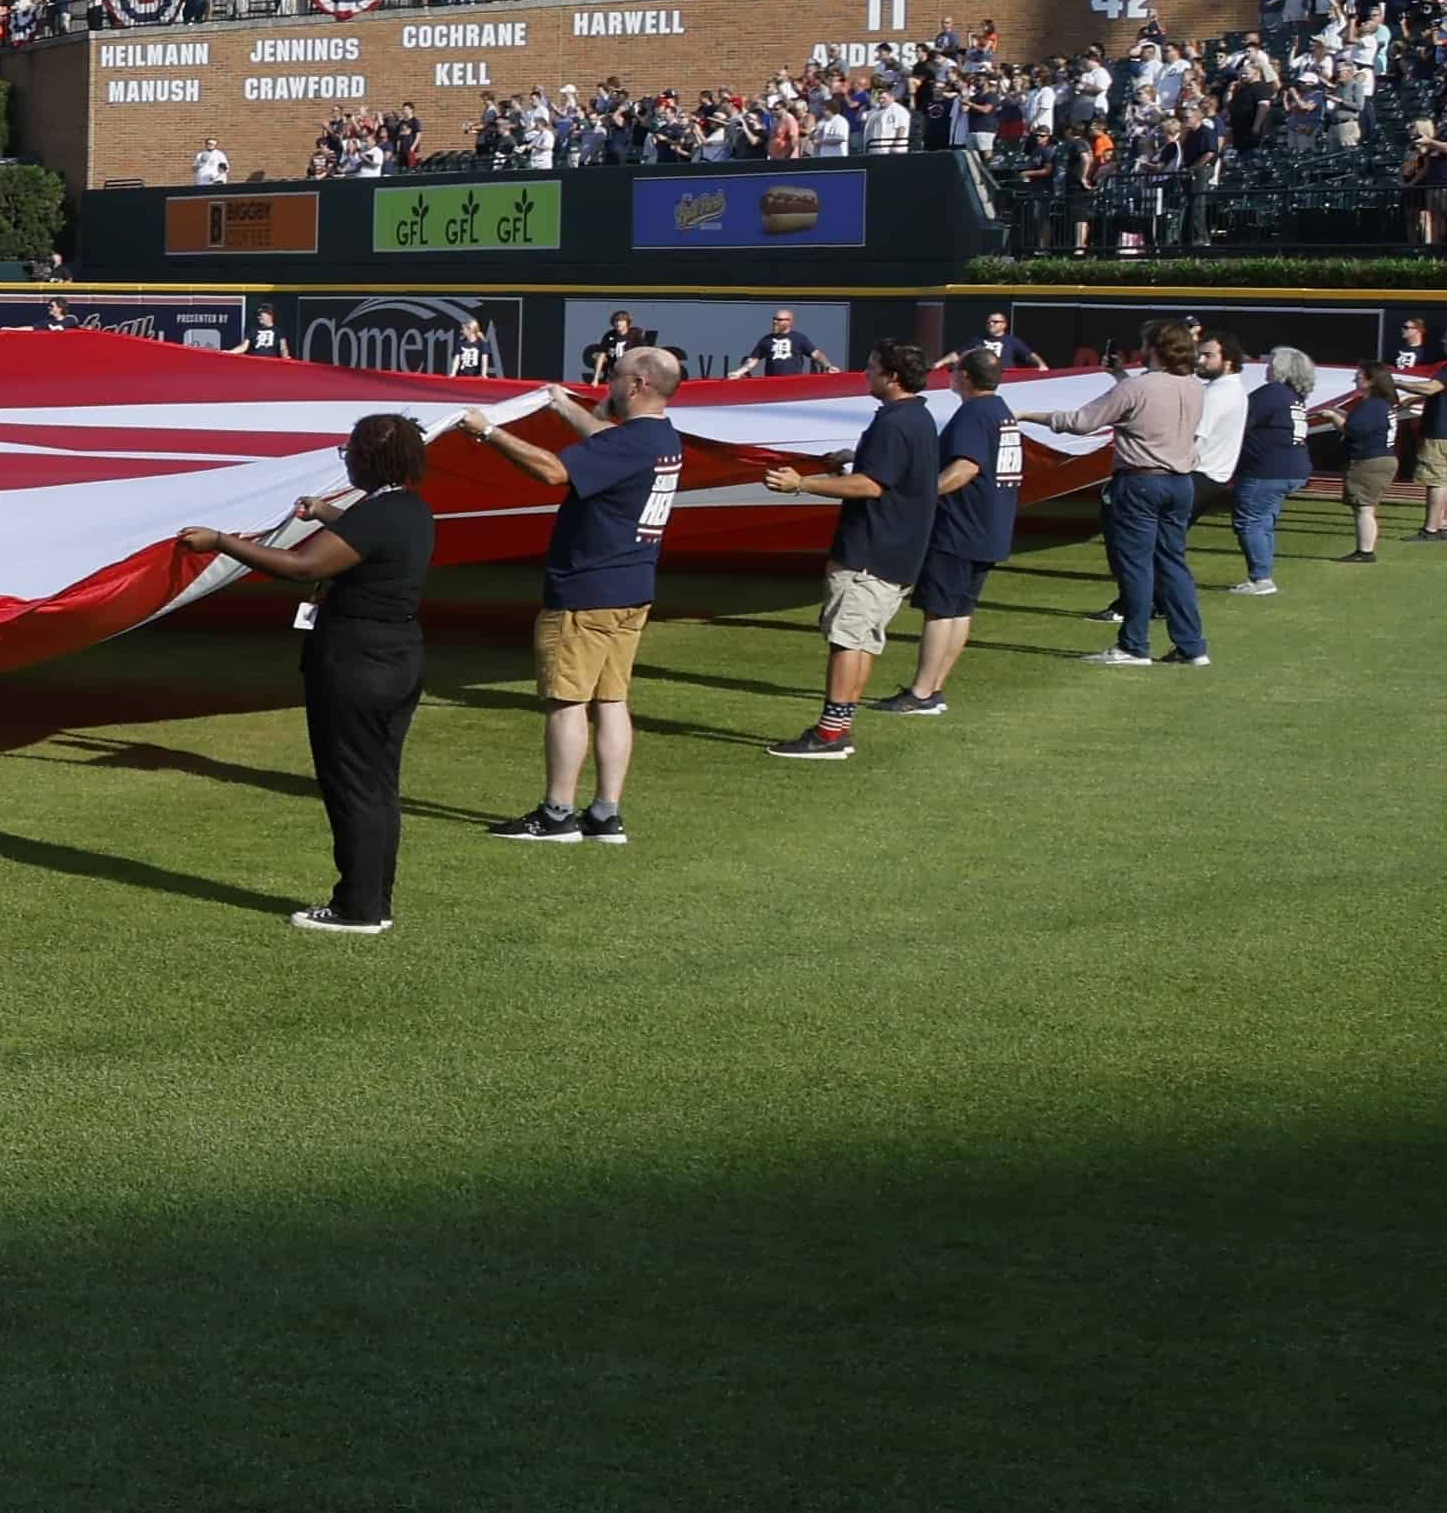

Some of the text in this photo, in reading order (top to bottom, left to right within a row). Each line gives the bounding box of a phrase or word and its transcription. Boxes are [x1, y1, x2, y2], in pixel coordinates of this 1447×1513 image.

[402, 22, 528, 49] COCHRANE
[573, 10, 685, 36] HARWELL
[101, 43, 209, 67] HEILMANN
[250, 37, 360, 63] JENNINGS
[434, 62, 491, 86] KELL
[108, 80, 201, 103] MANUSH
[244, 75, 366, 100] CRAWFORD
[396, 208, 429, 246] GFL
[445, 207, 479, 245] GFL
[496, 206, 535, 244] GFL
[176, 313, 229, 324] PRESENTED BY
